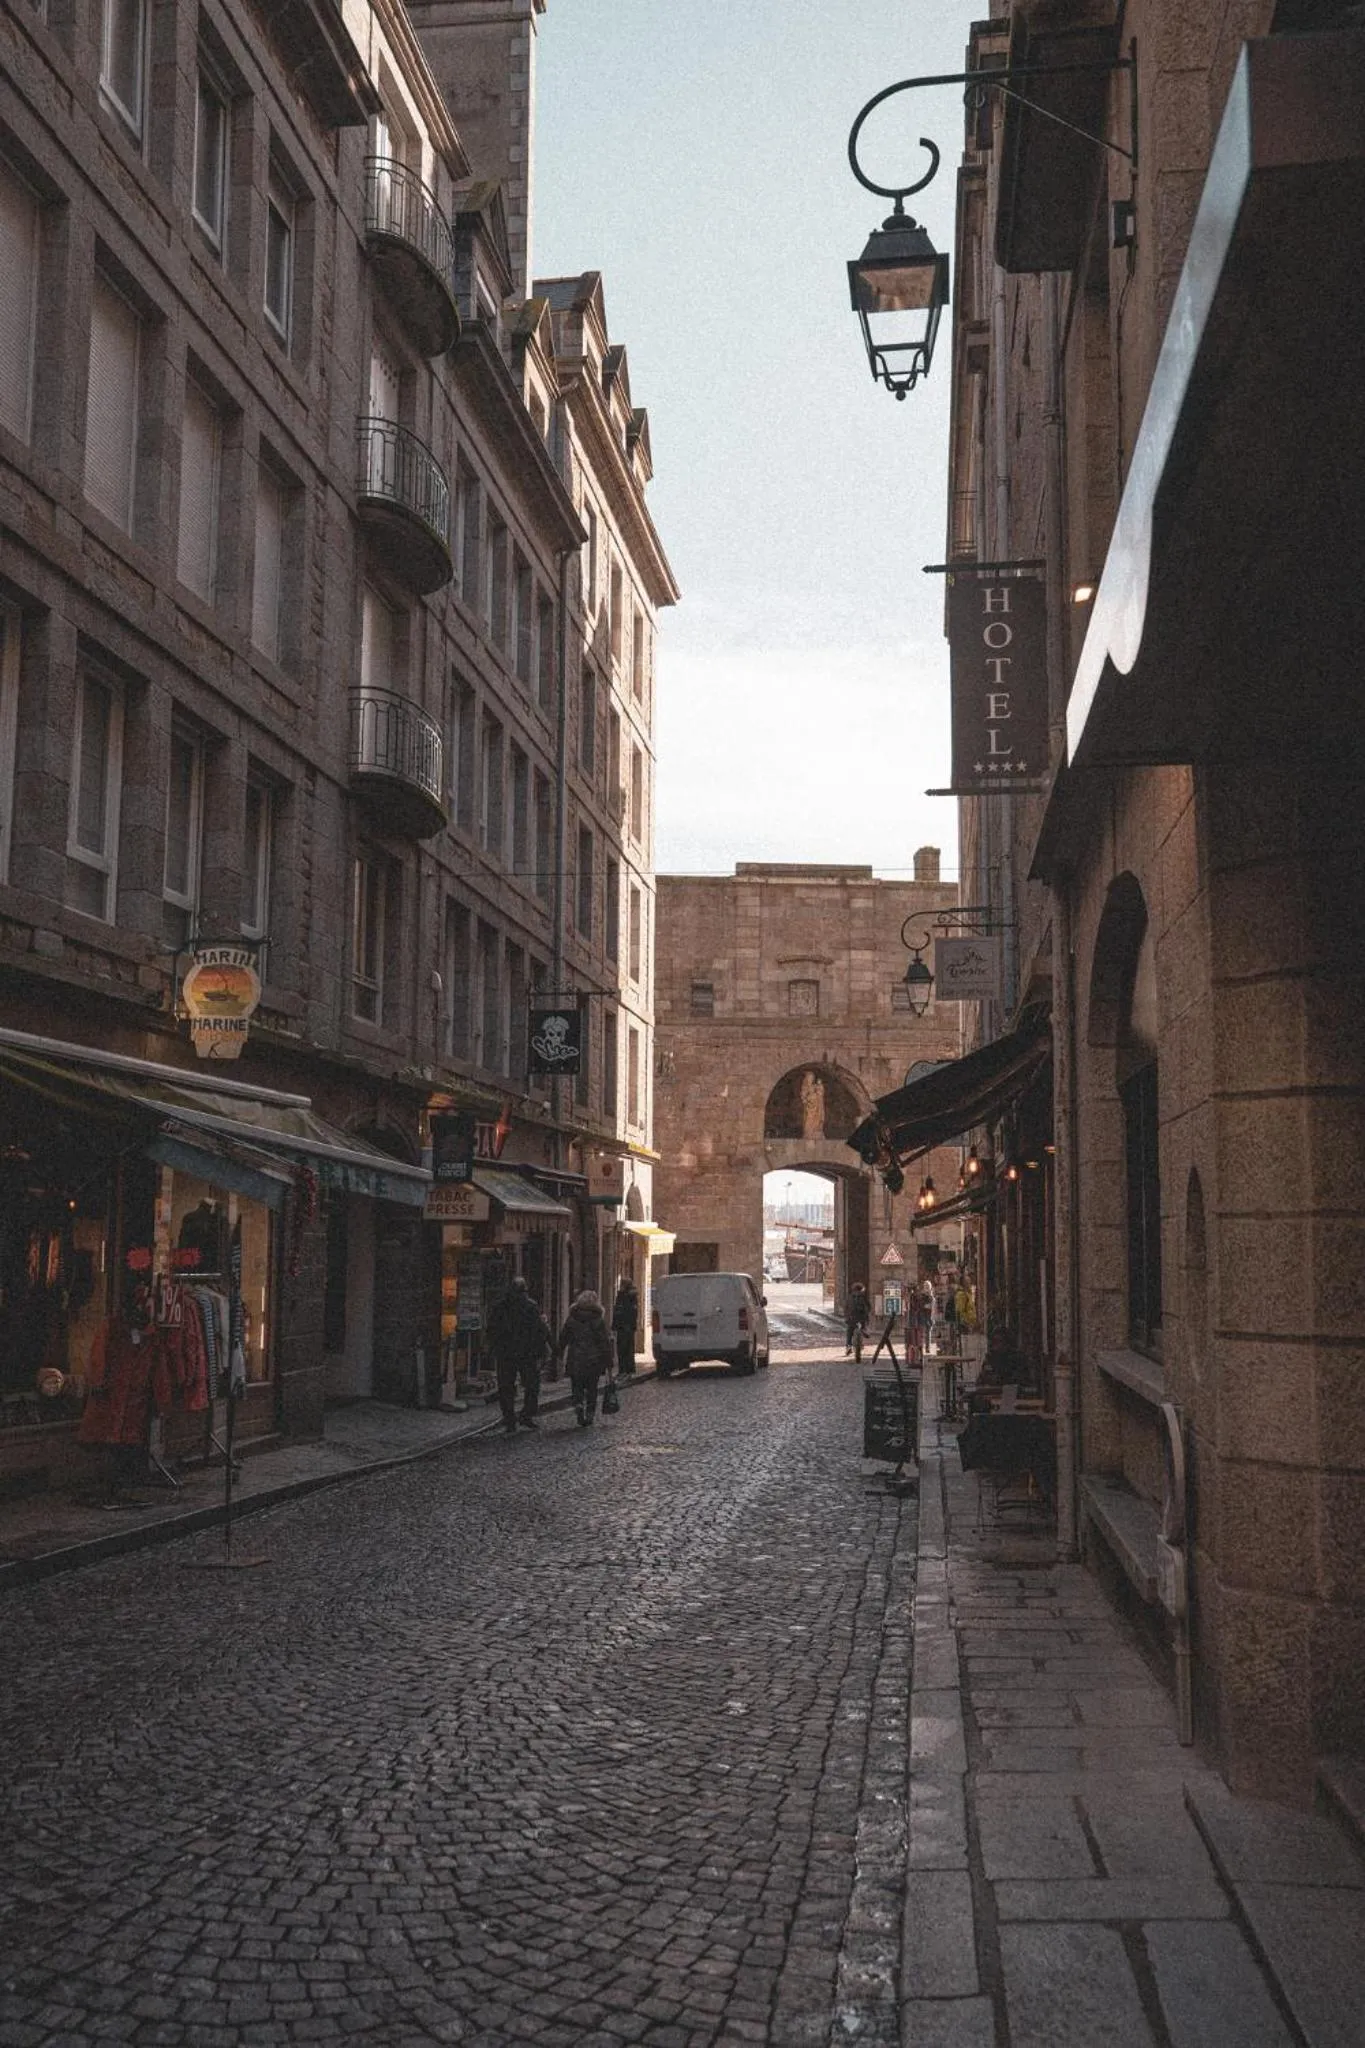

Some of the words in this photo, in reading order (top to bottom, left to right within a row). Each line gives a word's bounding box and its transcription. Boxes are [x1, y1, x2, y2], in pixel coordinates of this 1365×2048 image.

[982, 587, 1013, 755] HOTEL
[193, 1018, 247, 1031] MARINE
[429, 1190, 471, 1202] TABAC
[427, 1203, 475, 1215] PRESSE
